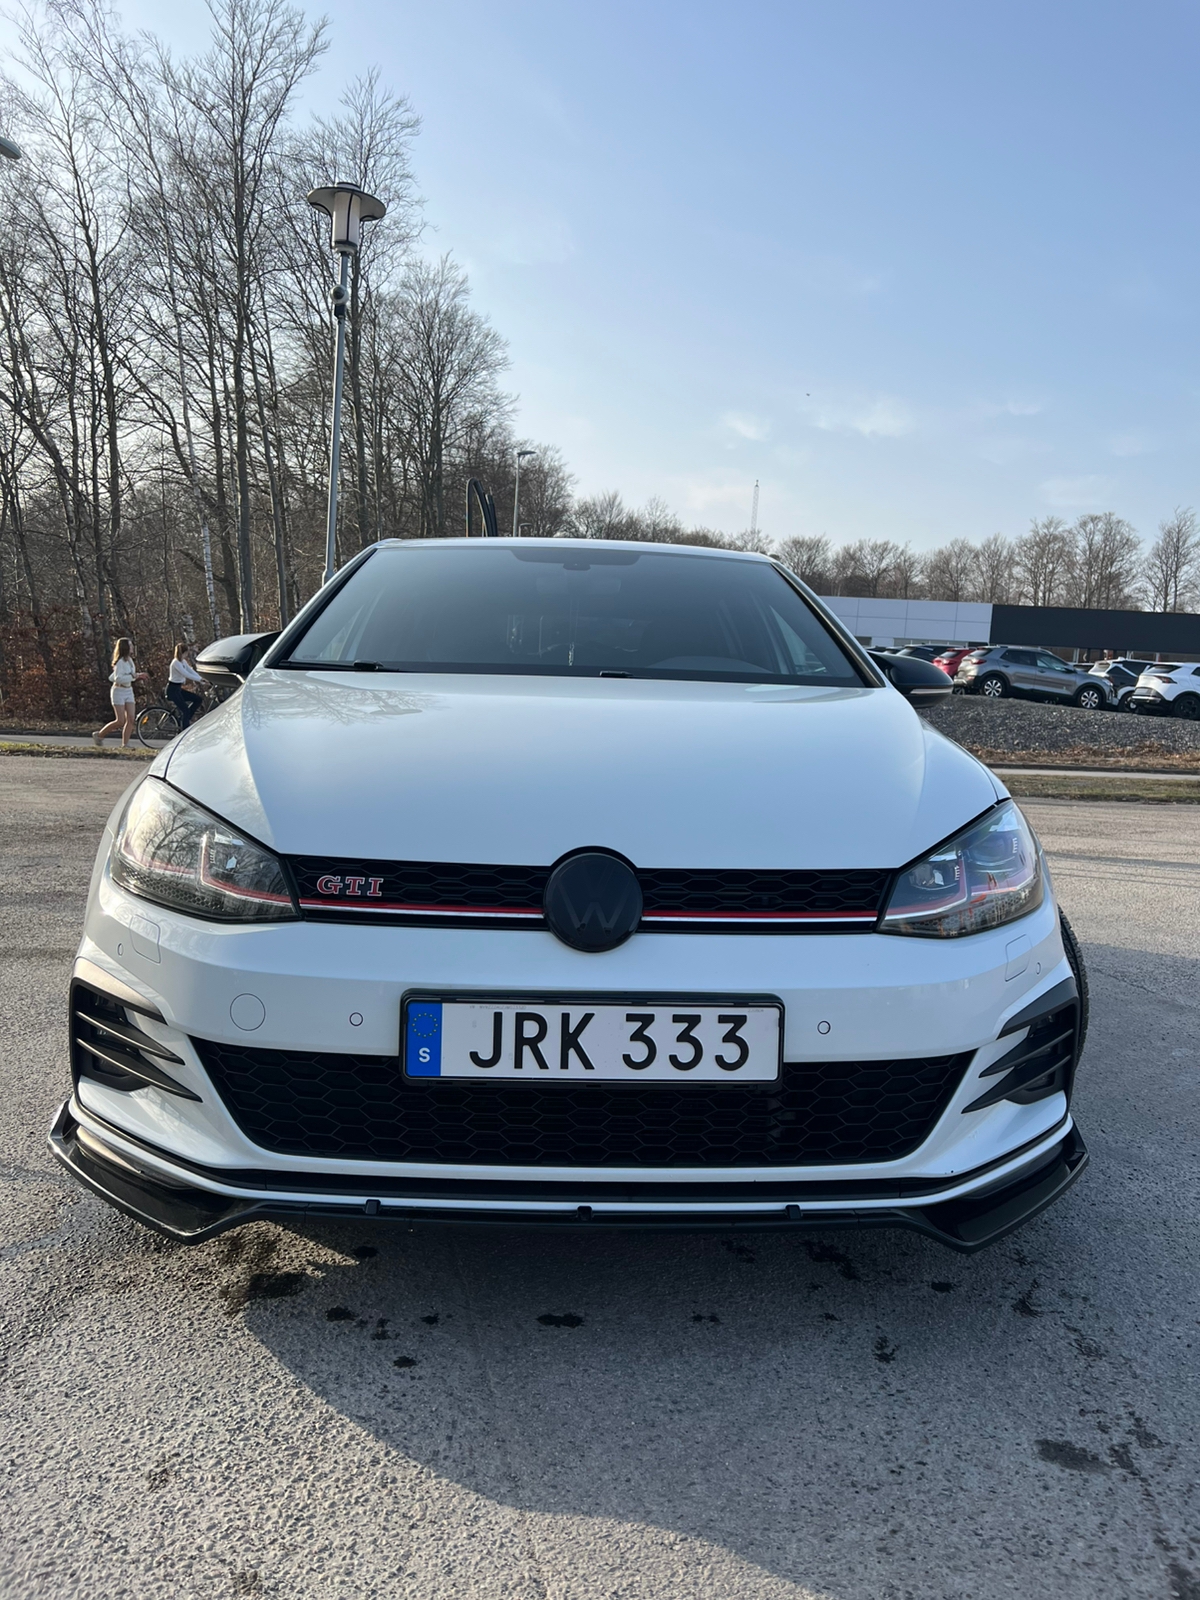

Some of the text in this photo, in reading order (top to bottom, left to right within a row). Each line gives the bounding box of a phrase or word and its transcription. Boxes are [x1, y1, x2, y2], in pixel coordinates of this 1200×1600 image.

[316, 874, 384, 896] GTI
[469, 1011, 750, 1071] JRK 333
[418, 1047, 431, 1063] S
